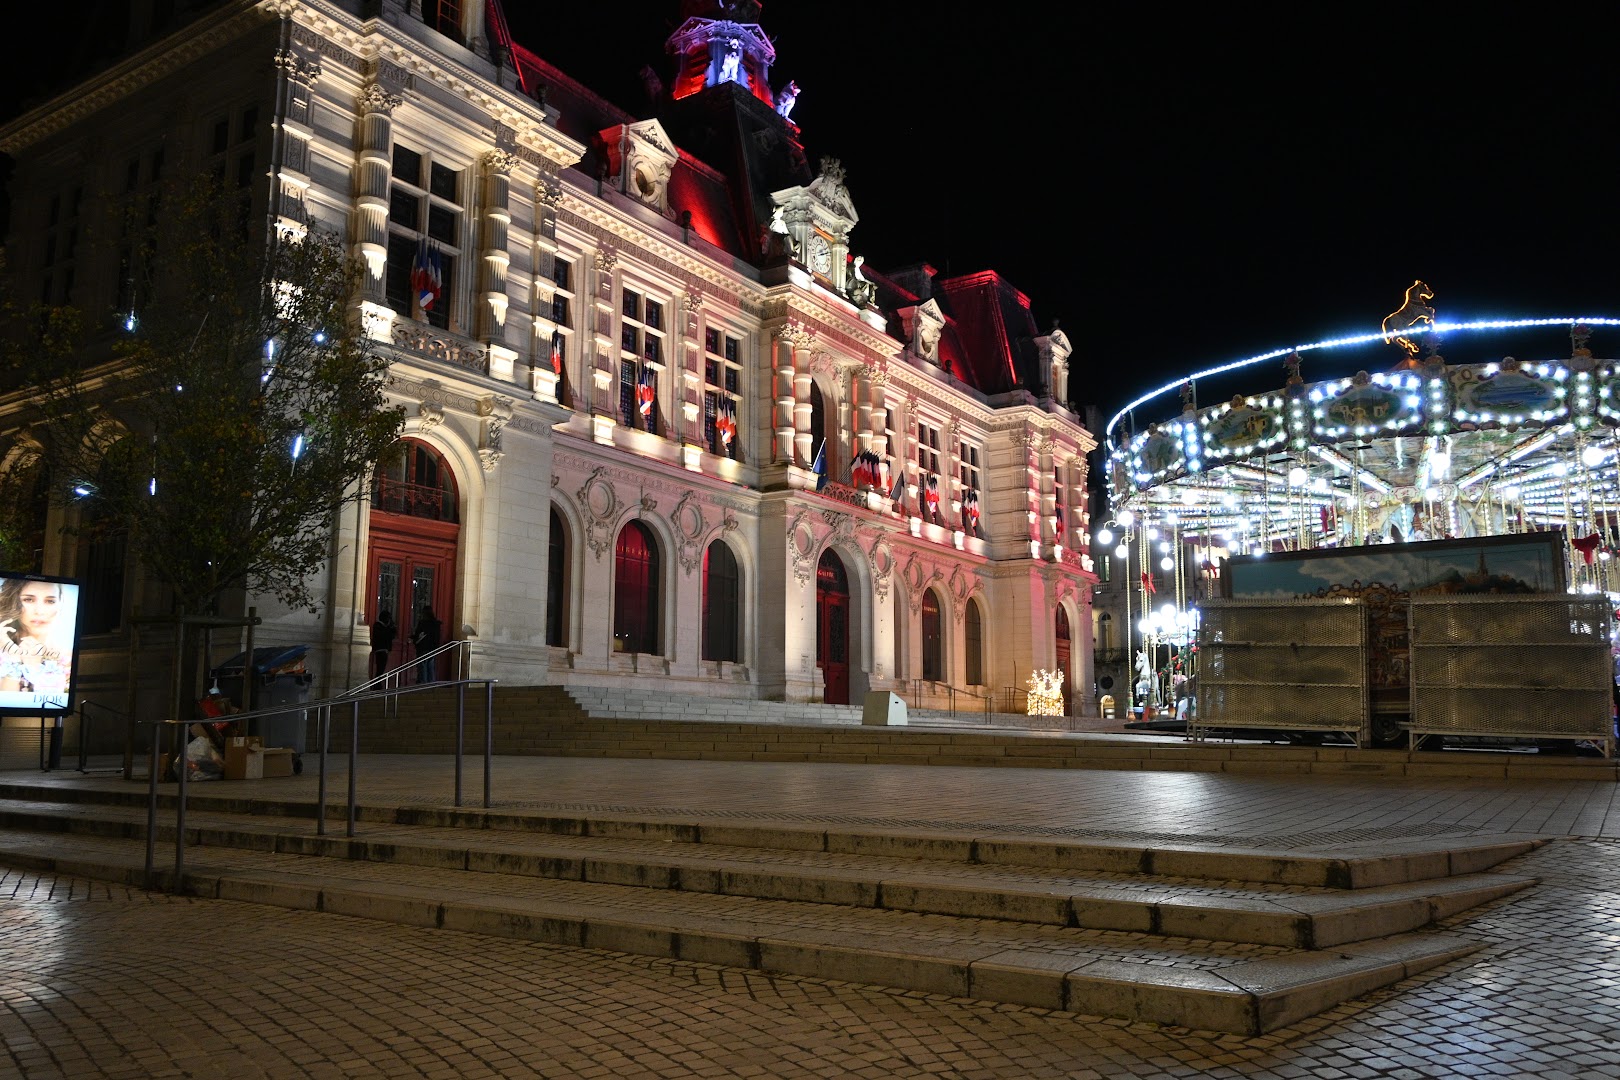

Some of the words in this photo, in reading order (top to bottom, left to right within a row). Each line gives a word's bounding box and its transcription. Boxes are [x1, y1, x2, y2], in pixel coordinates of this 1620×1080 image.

[2, 641, 29, 655] Miss
[31, 643, 60, 657] Dior
[33, 695, 62, 704] DIOR
